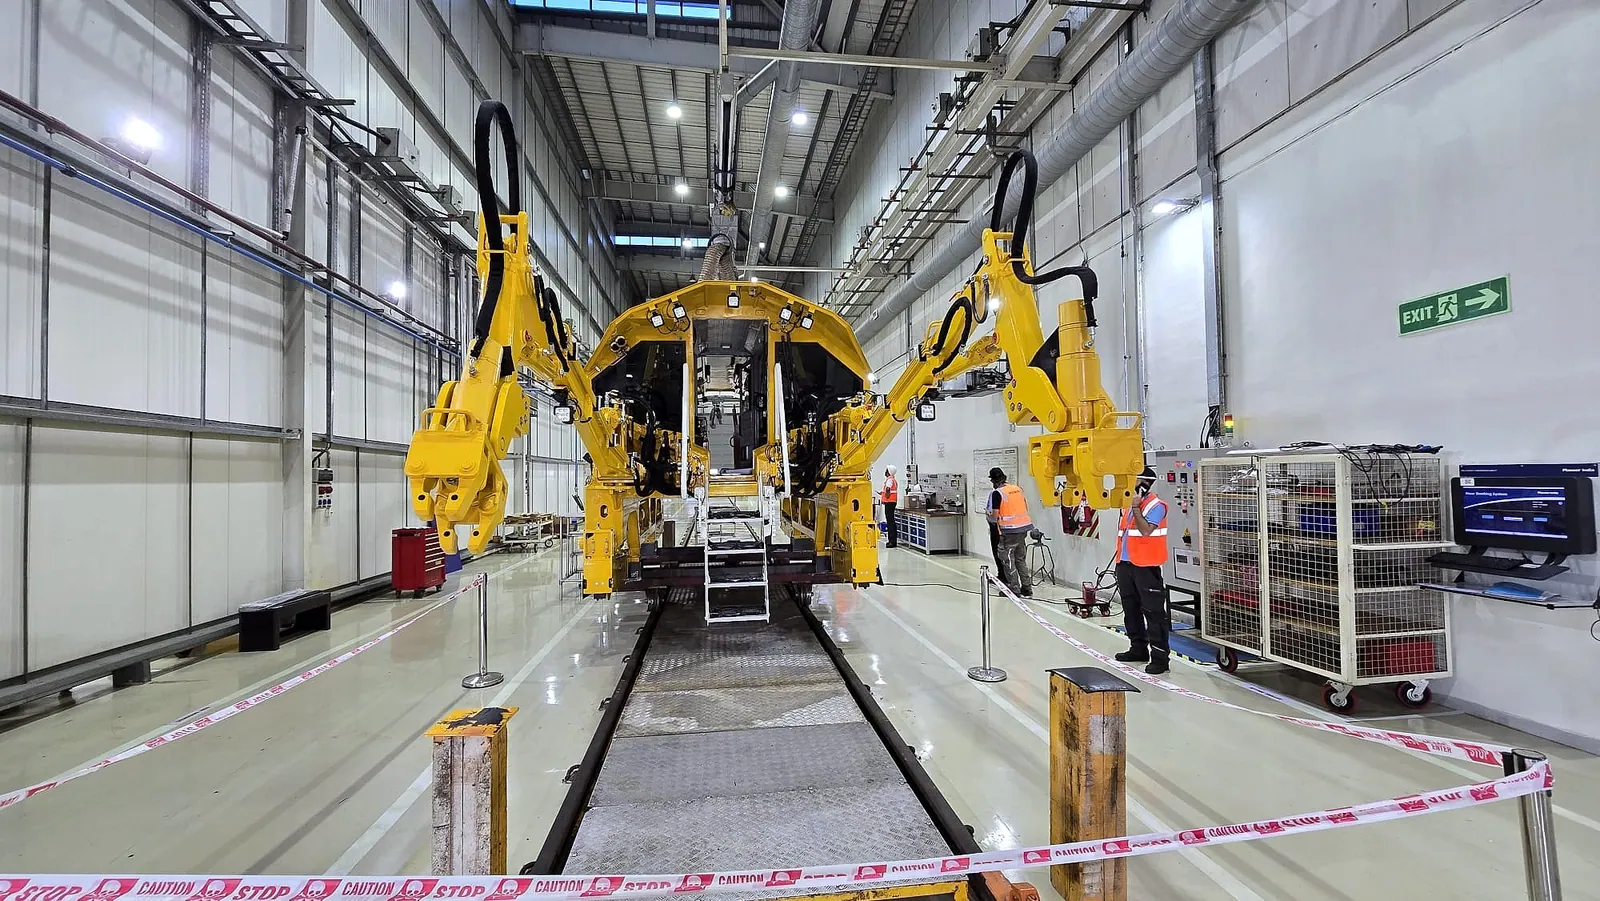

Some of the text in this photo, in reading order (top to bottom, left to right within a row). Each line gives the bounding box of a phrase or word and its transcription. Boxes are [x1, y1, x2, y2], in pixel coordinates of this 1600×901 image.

[1403, 305, 1434, 325] EXIT
[136, 881, 196, 896] CAUTION
[232, 885, 291, 900] STOP
[341, 881, 396, 896] CAUTION
[433, 885, 486, 898] STOP
[534, 879, 584, 893] CAUTION
